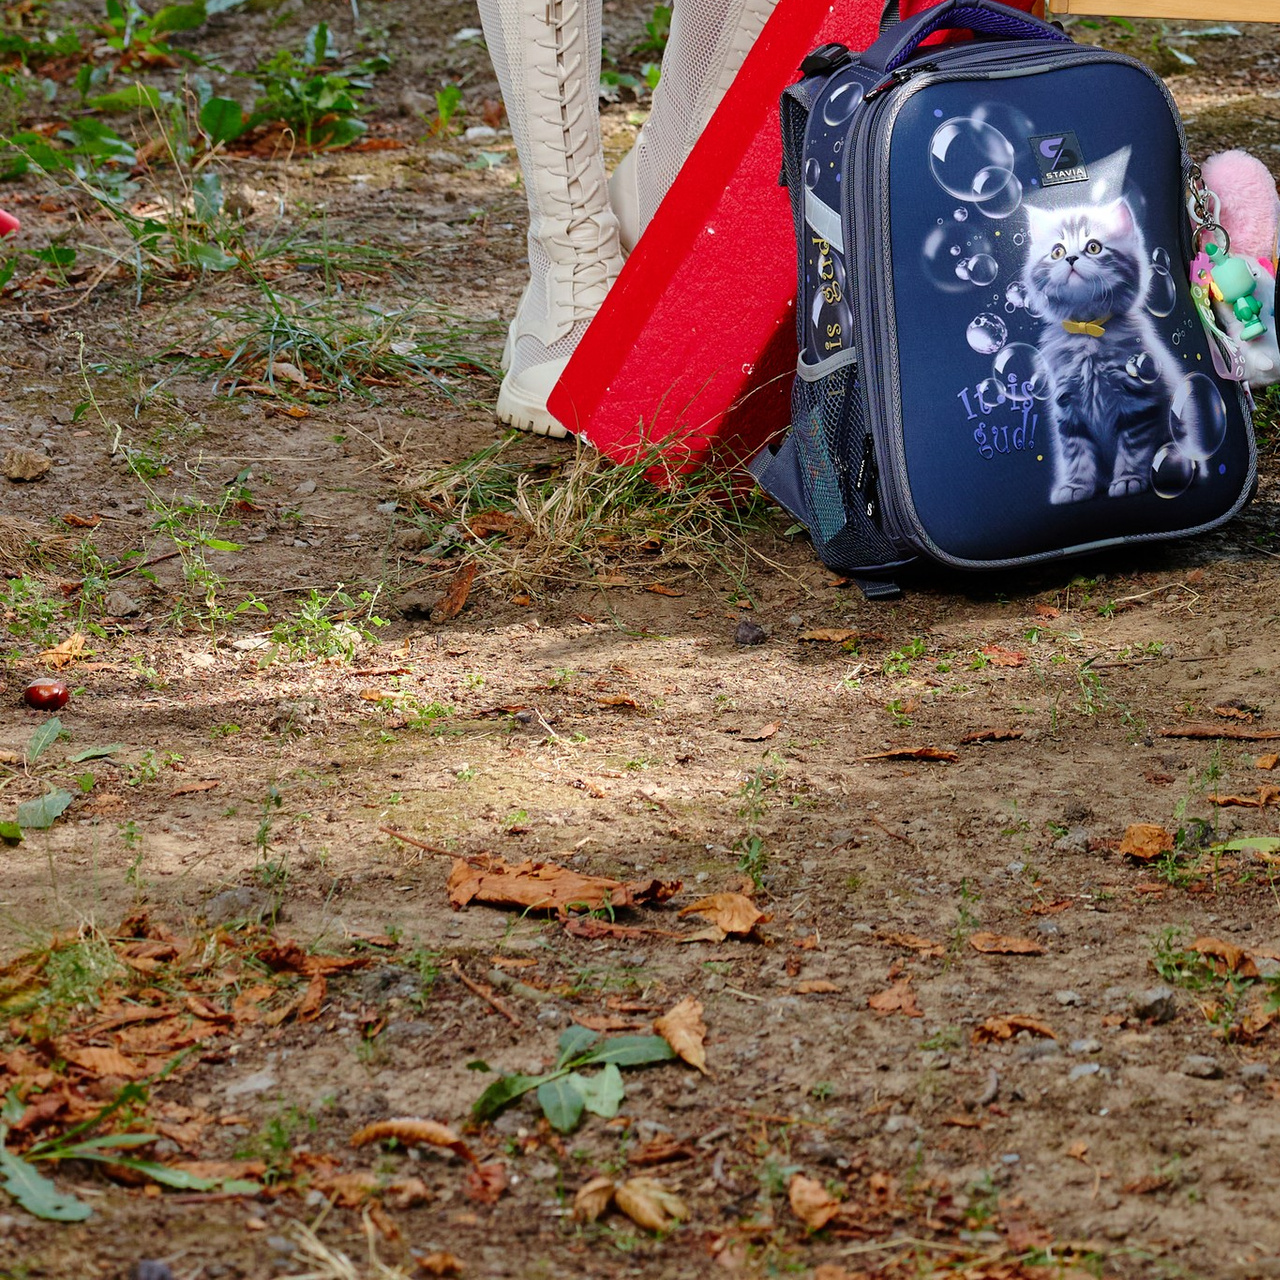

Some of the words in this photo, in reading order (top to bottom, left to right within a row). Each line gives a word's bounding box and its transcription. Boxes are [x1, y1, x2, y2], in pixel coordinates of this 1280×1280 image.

[1045, 168, 1084, 180] STAVIA
[957, 383, 993, 421] It
[1007, 372, 1036, 412] is
